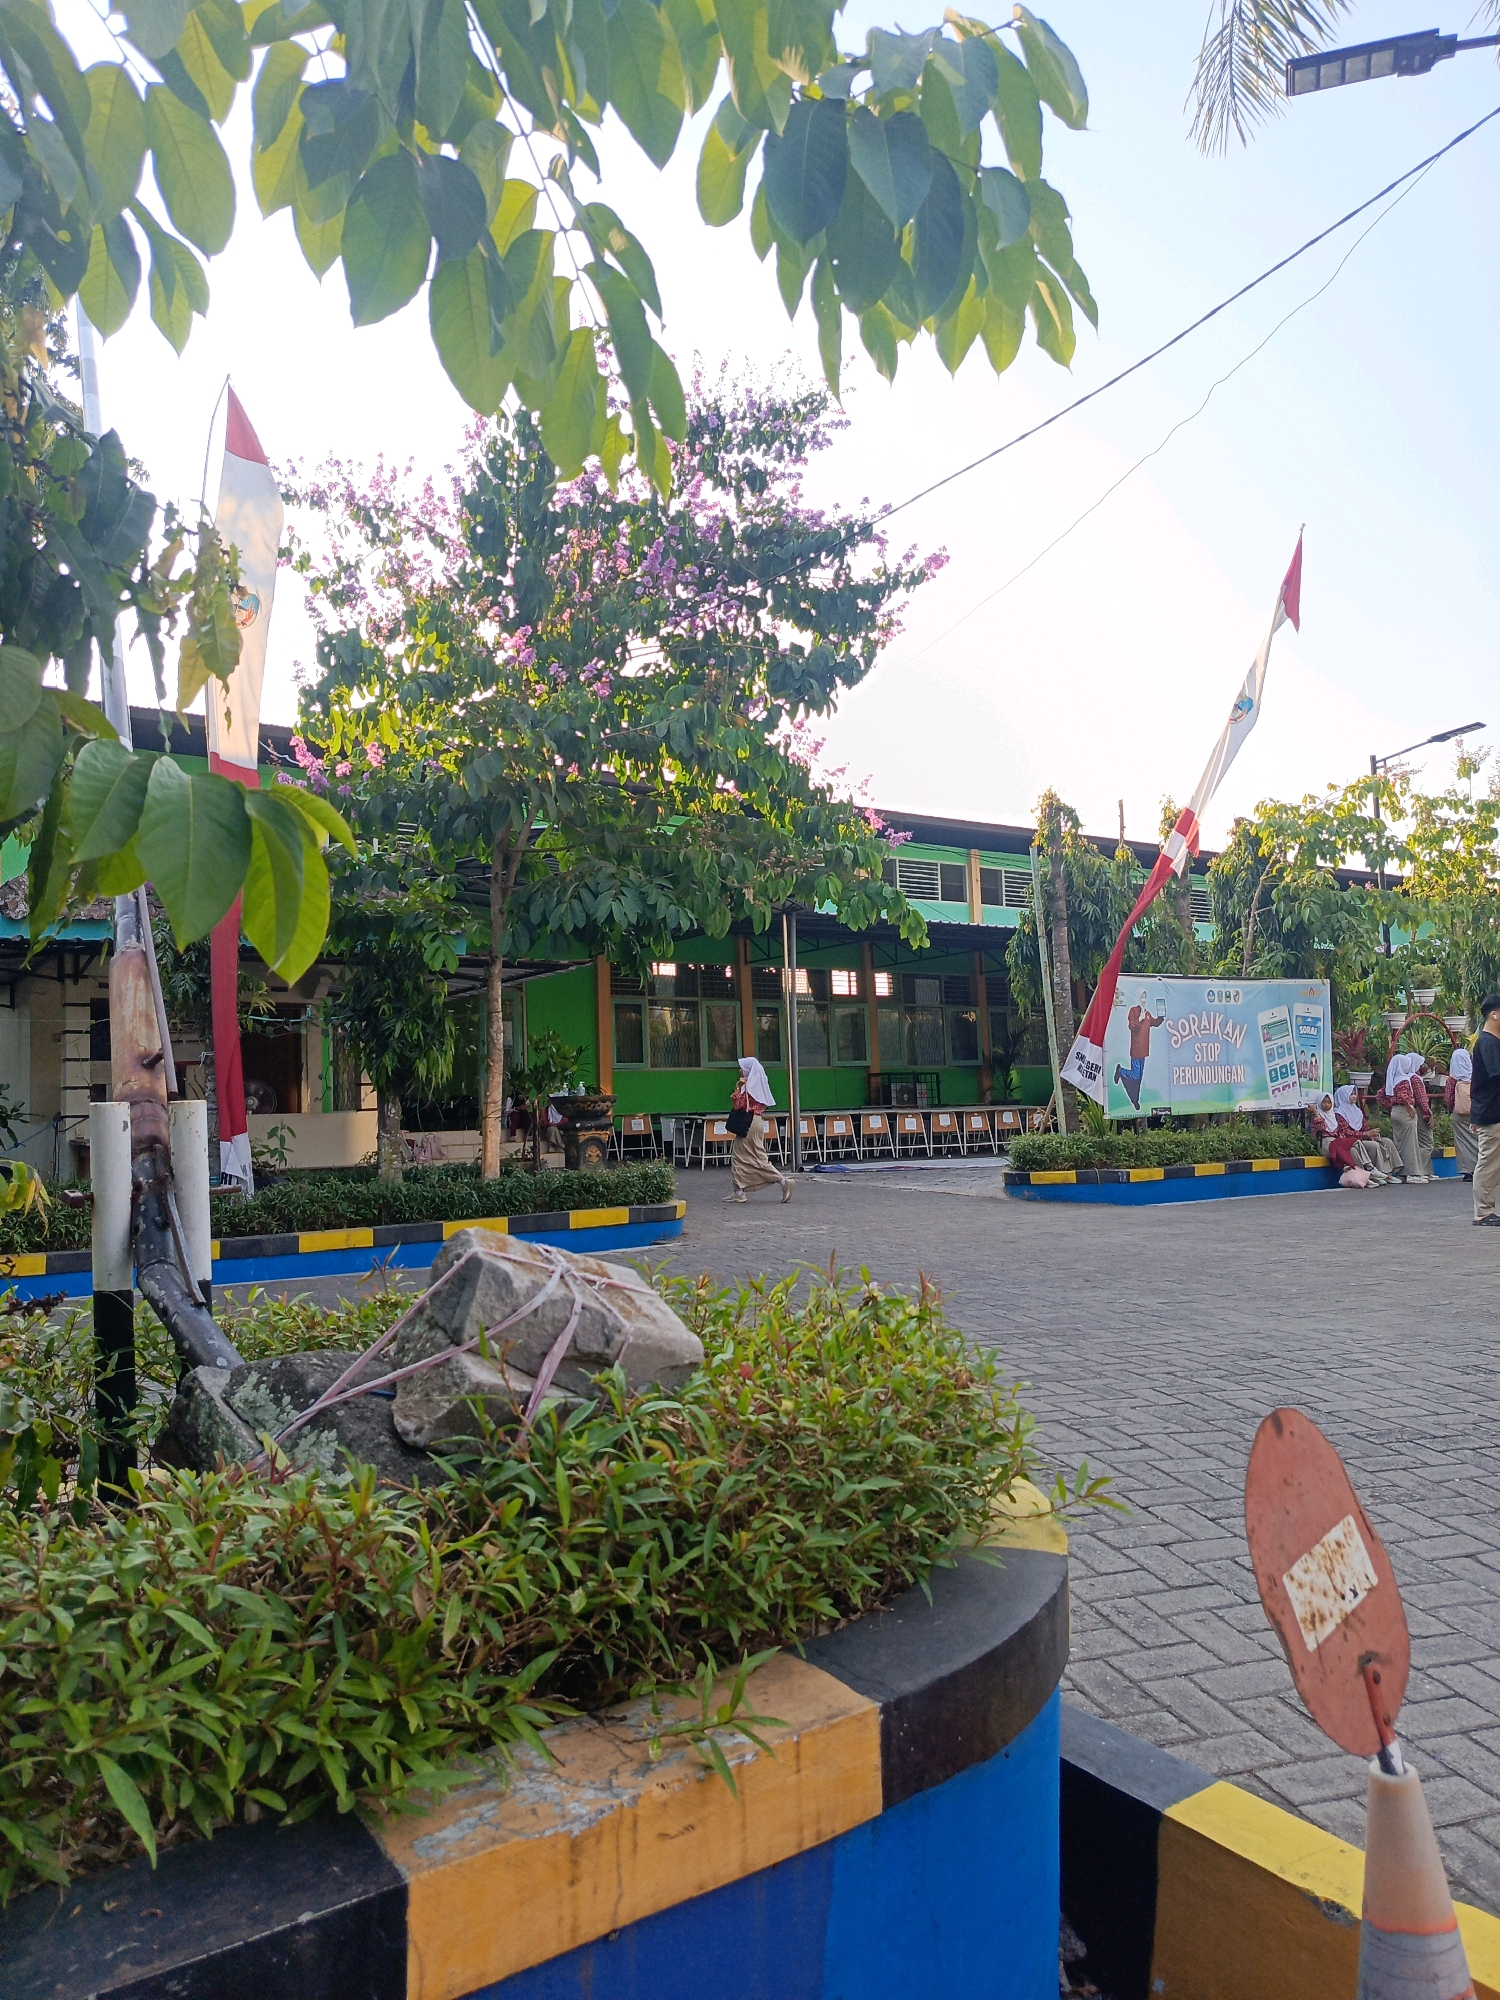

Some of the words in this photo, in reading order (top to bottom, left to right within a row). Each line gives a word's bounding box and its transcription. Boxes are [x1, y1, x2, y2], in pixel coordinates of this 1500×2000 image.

[1166, 1010, 1248, 1049] SORAIKAN
[1194, 1042, 1221, 1063] STOP
[1173, 1065, 1245, 1085] PERUNDUNGAN
